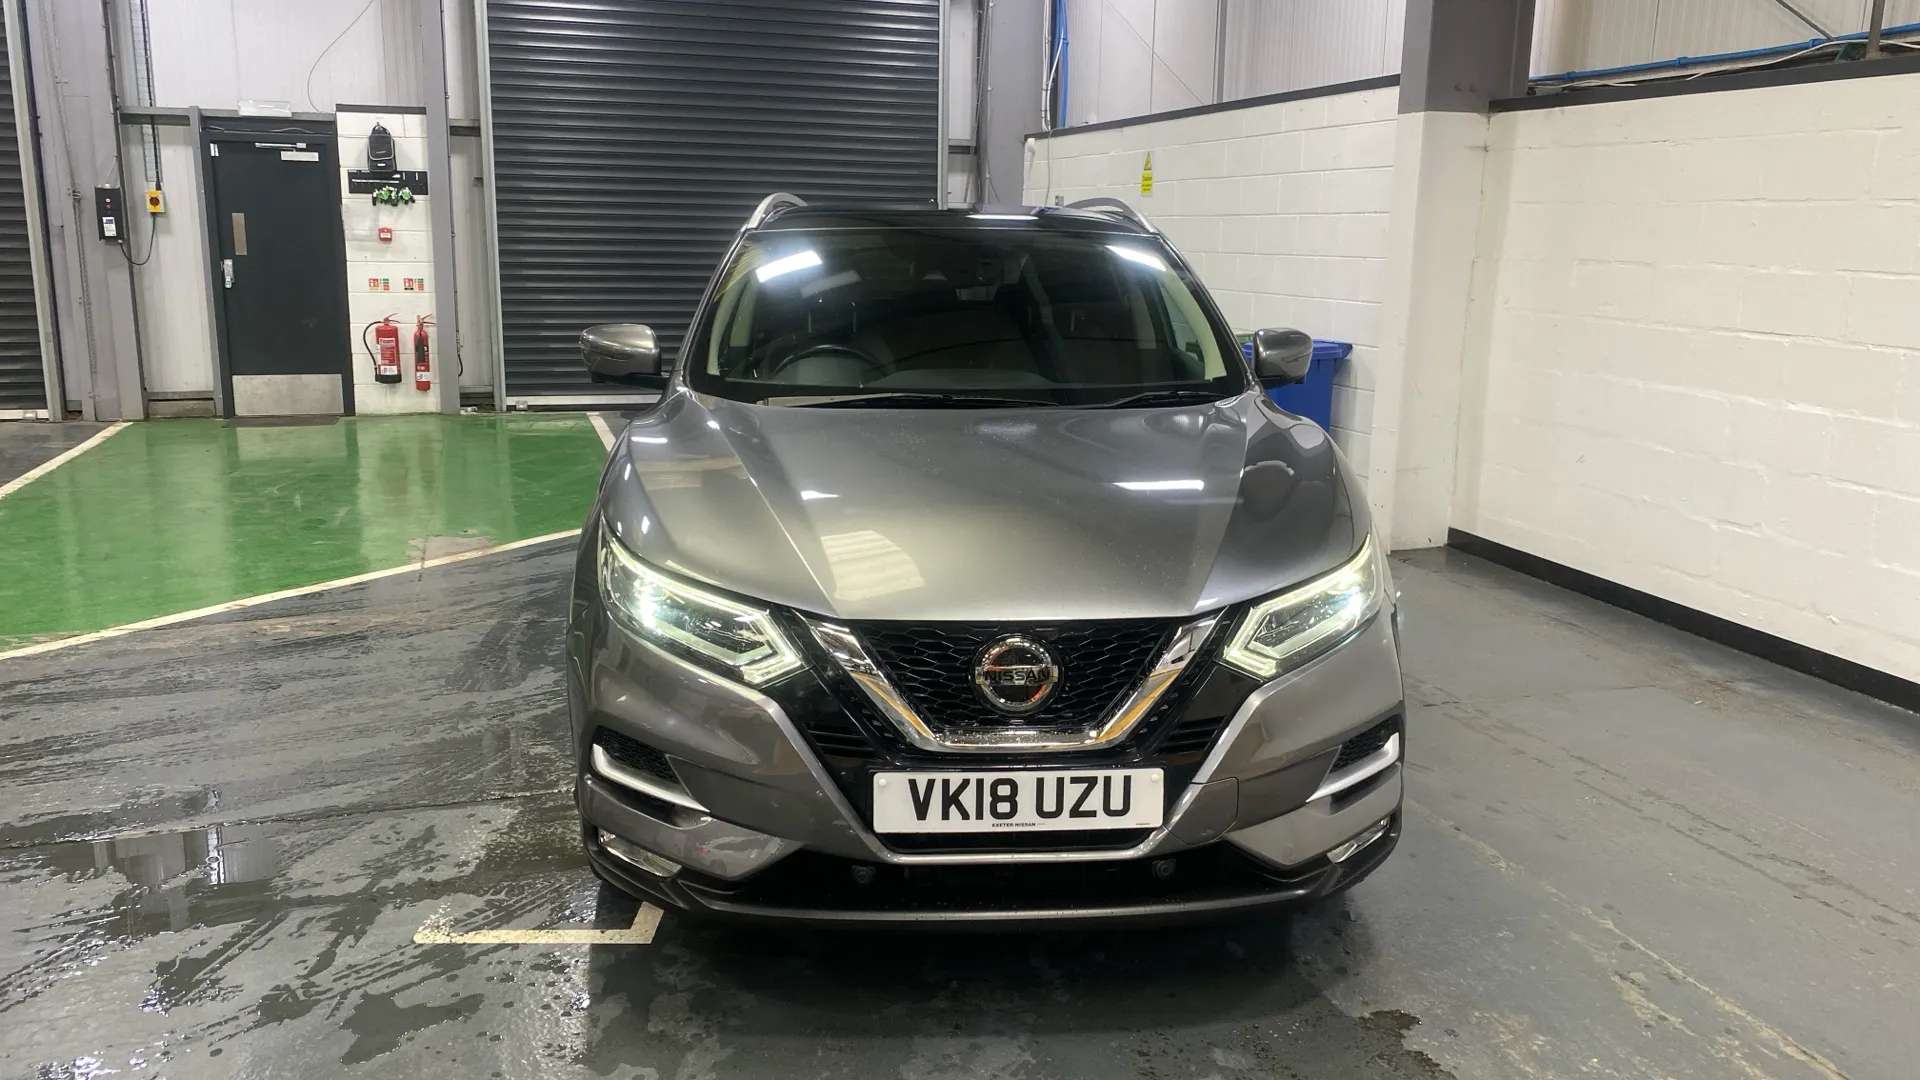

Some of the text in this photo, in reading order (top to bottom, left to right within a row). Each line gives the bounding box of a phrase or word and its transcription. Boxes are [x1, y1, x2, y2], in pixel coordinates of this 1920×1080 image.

[984, 668, 1051, 682] NISSAN
[908, 775, 1132, 820] VK18 UZU
